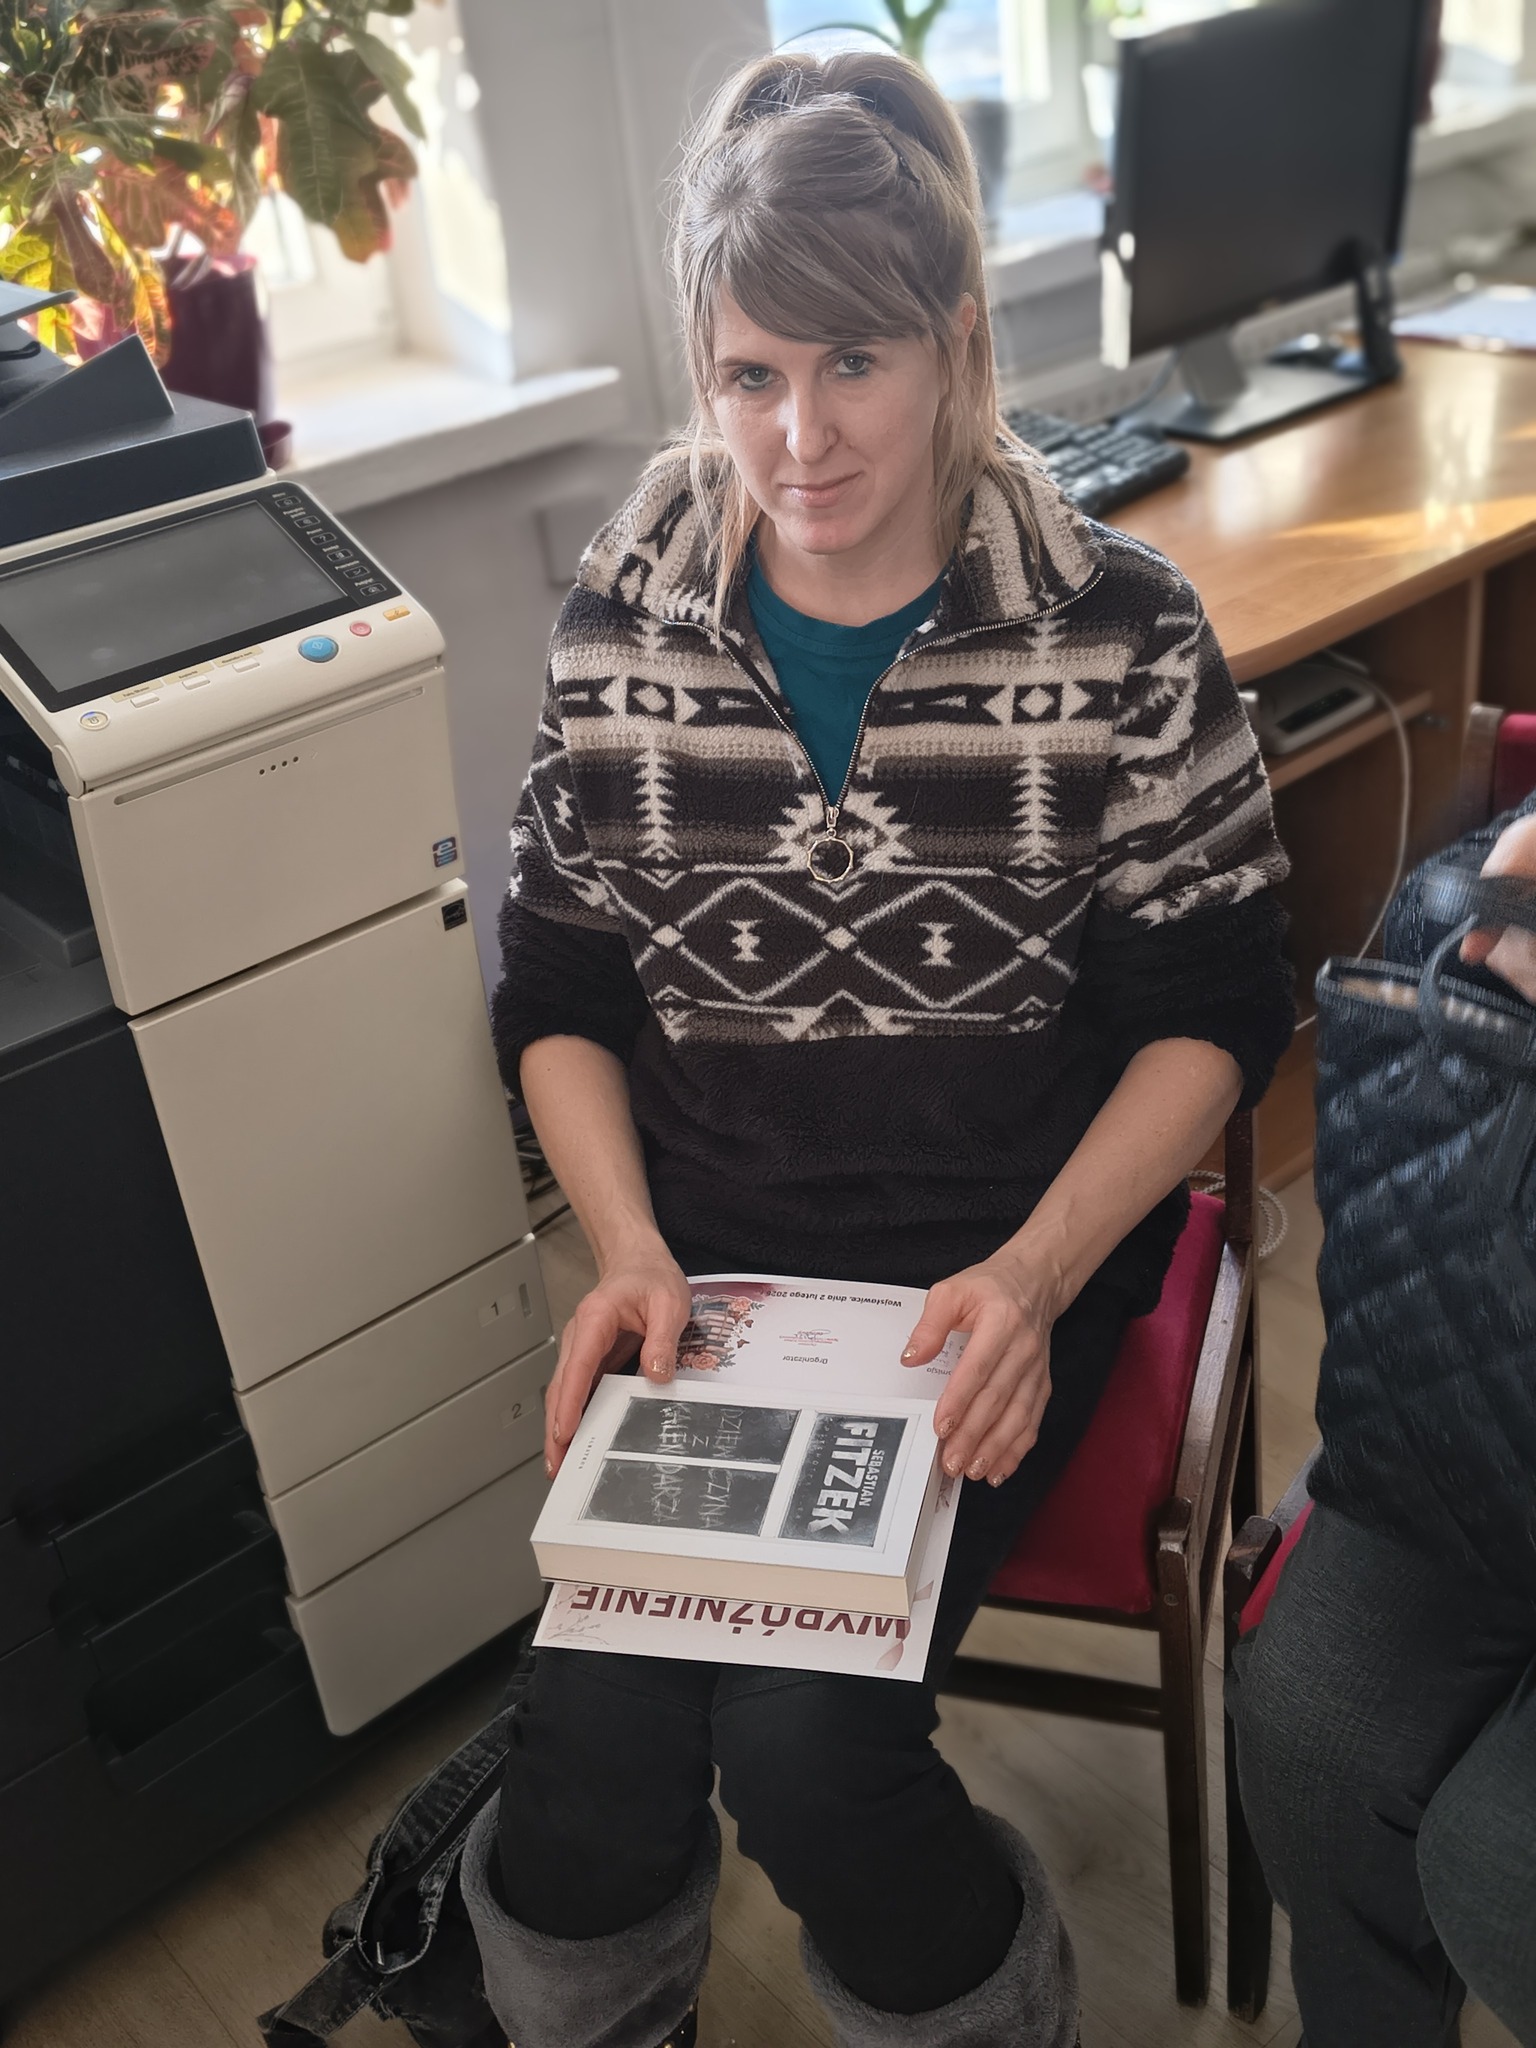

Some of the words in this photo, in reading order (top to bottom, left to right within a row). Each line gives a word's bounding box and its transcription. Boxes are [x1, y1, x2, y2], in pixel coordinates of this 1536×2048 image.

[789, 1291, 818, 1301] lutego
[827, 1294, 847, 1303] dnia
[490, 1302, 499, 1317] 1
[782, 1355, 828, 1365] Organizator
[926, 1367, 952, 1377] omisja
[511, 1403, 523, 1419] 2
[692, 1433, 709, 1448] Z
[807, 1422, 879, 1533] FITZEK
[859, 1449, 885, 1507] SEBASTIAN
